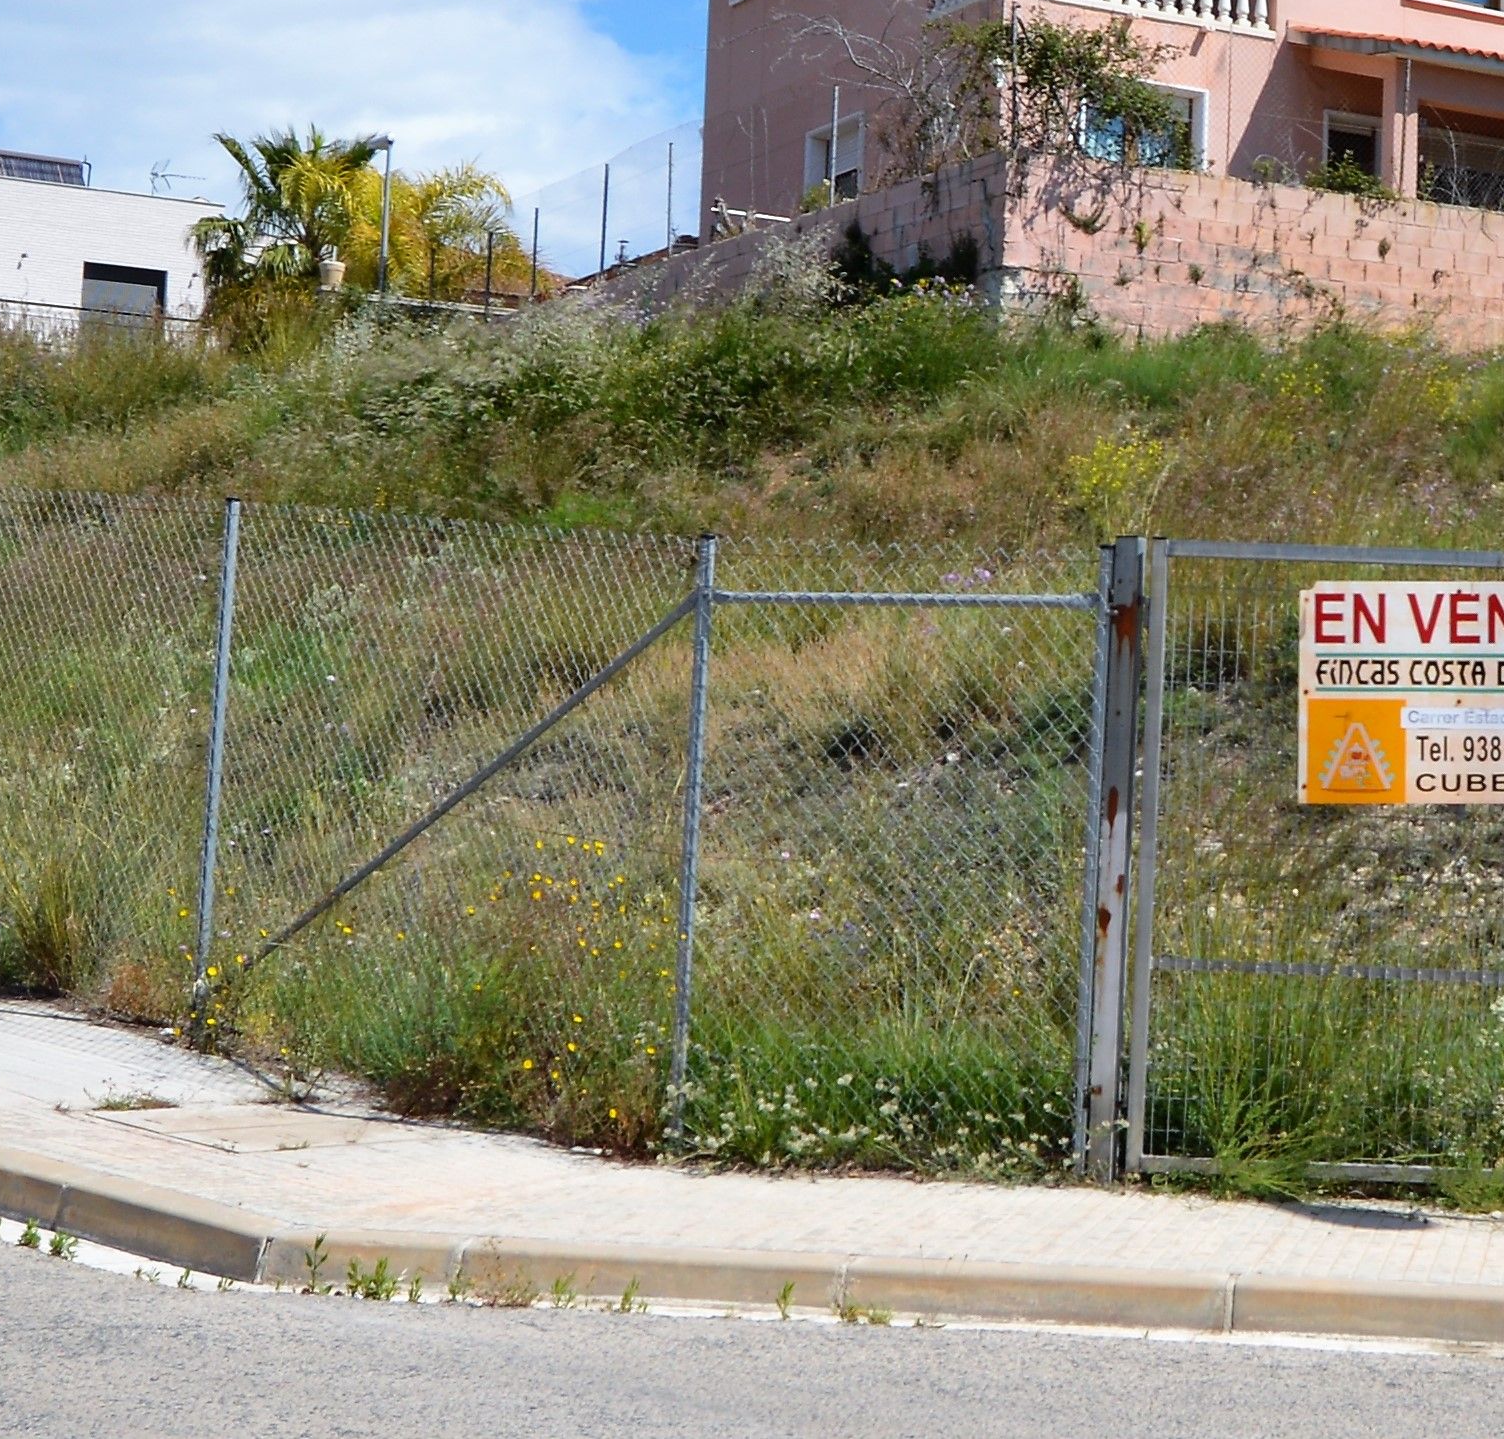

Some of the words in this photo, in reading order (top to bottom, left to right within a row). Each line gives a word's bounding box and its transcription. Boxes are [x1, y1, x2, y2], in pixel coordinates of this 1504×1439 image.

[1314, 593, 1387, 644] EN
[1409, 659, 1487, 686] COSTA
[1407, 710, 1460, 724] Carrer
[1415, 735, 1455, 762] Tel.
[1463, 735, 1502, 762] 938
